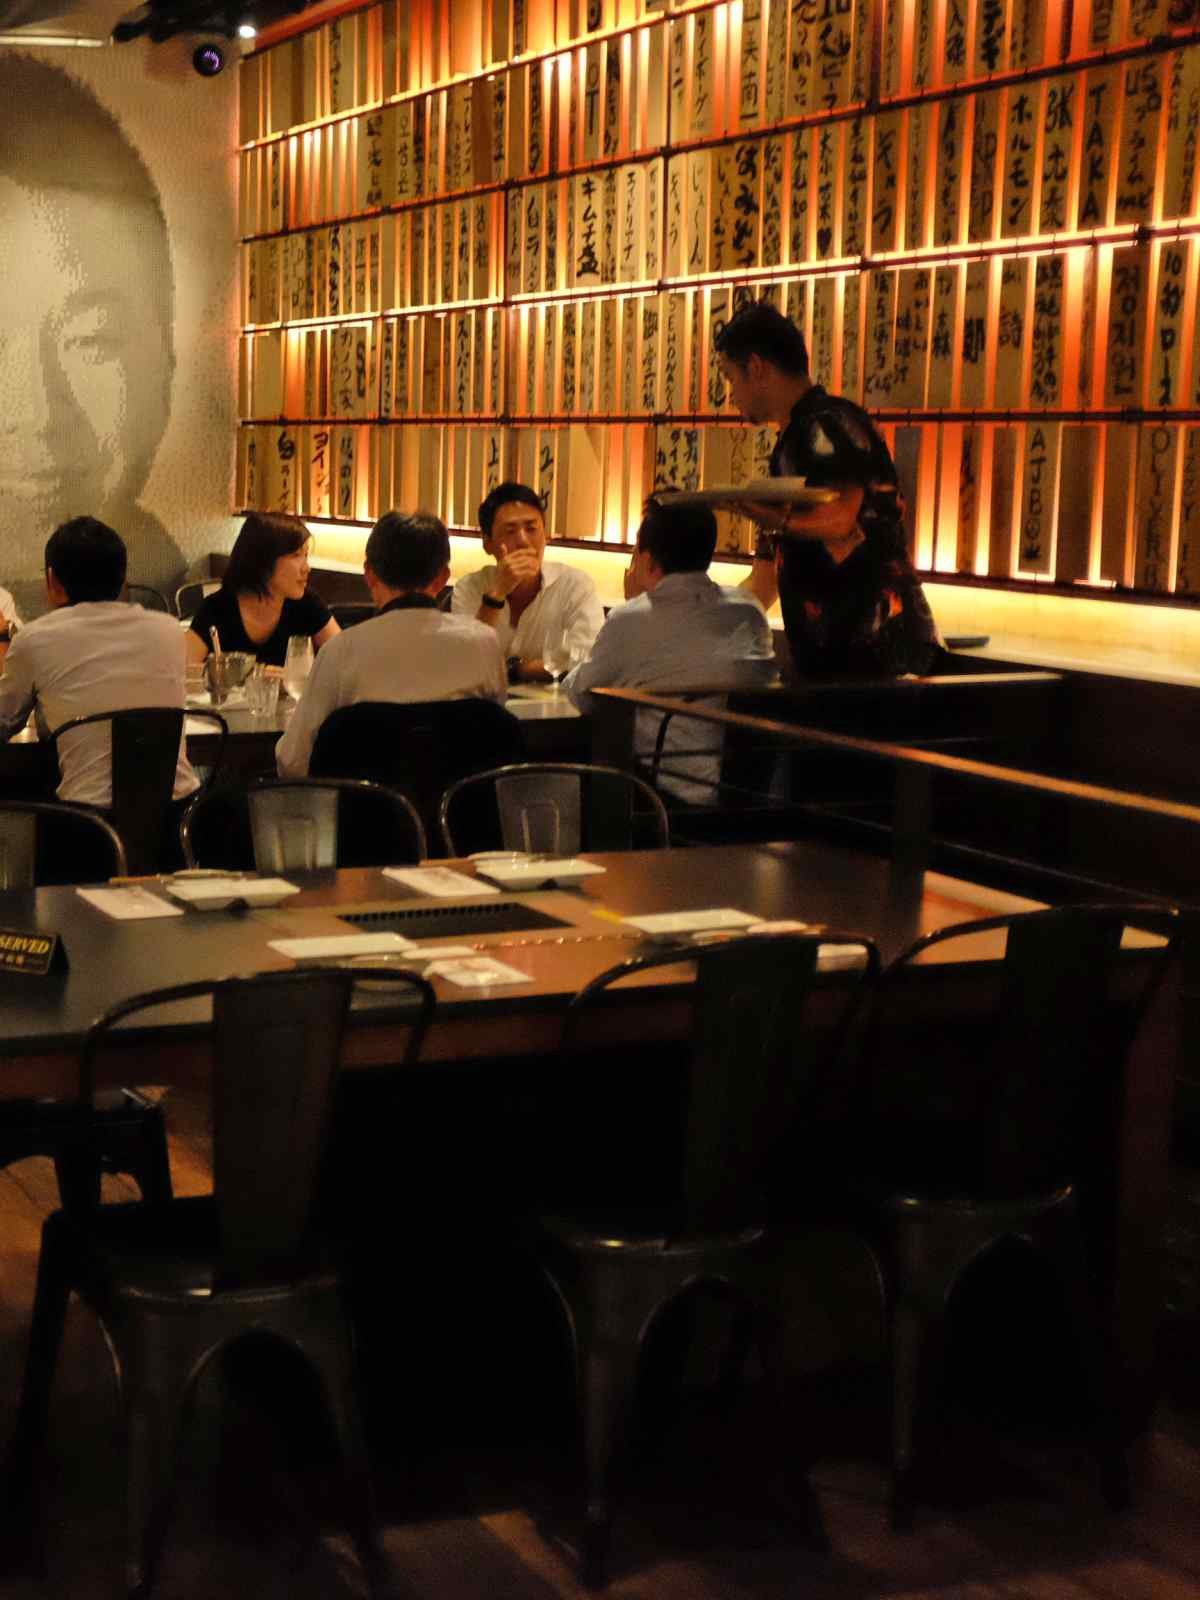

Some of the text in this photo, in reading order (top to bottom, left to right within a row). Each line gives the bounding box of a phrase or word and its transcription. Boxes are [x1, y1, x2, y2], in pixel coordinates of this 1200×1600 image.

[1008, 95, 1032, 226] ホルモン
[1082, 82, 1108, 222] TAKA
[576, 176, 600, 278] キムチ盛
